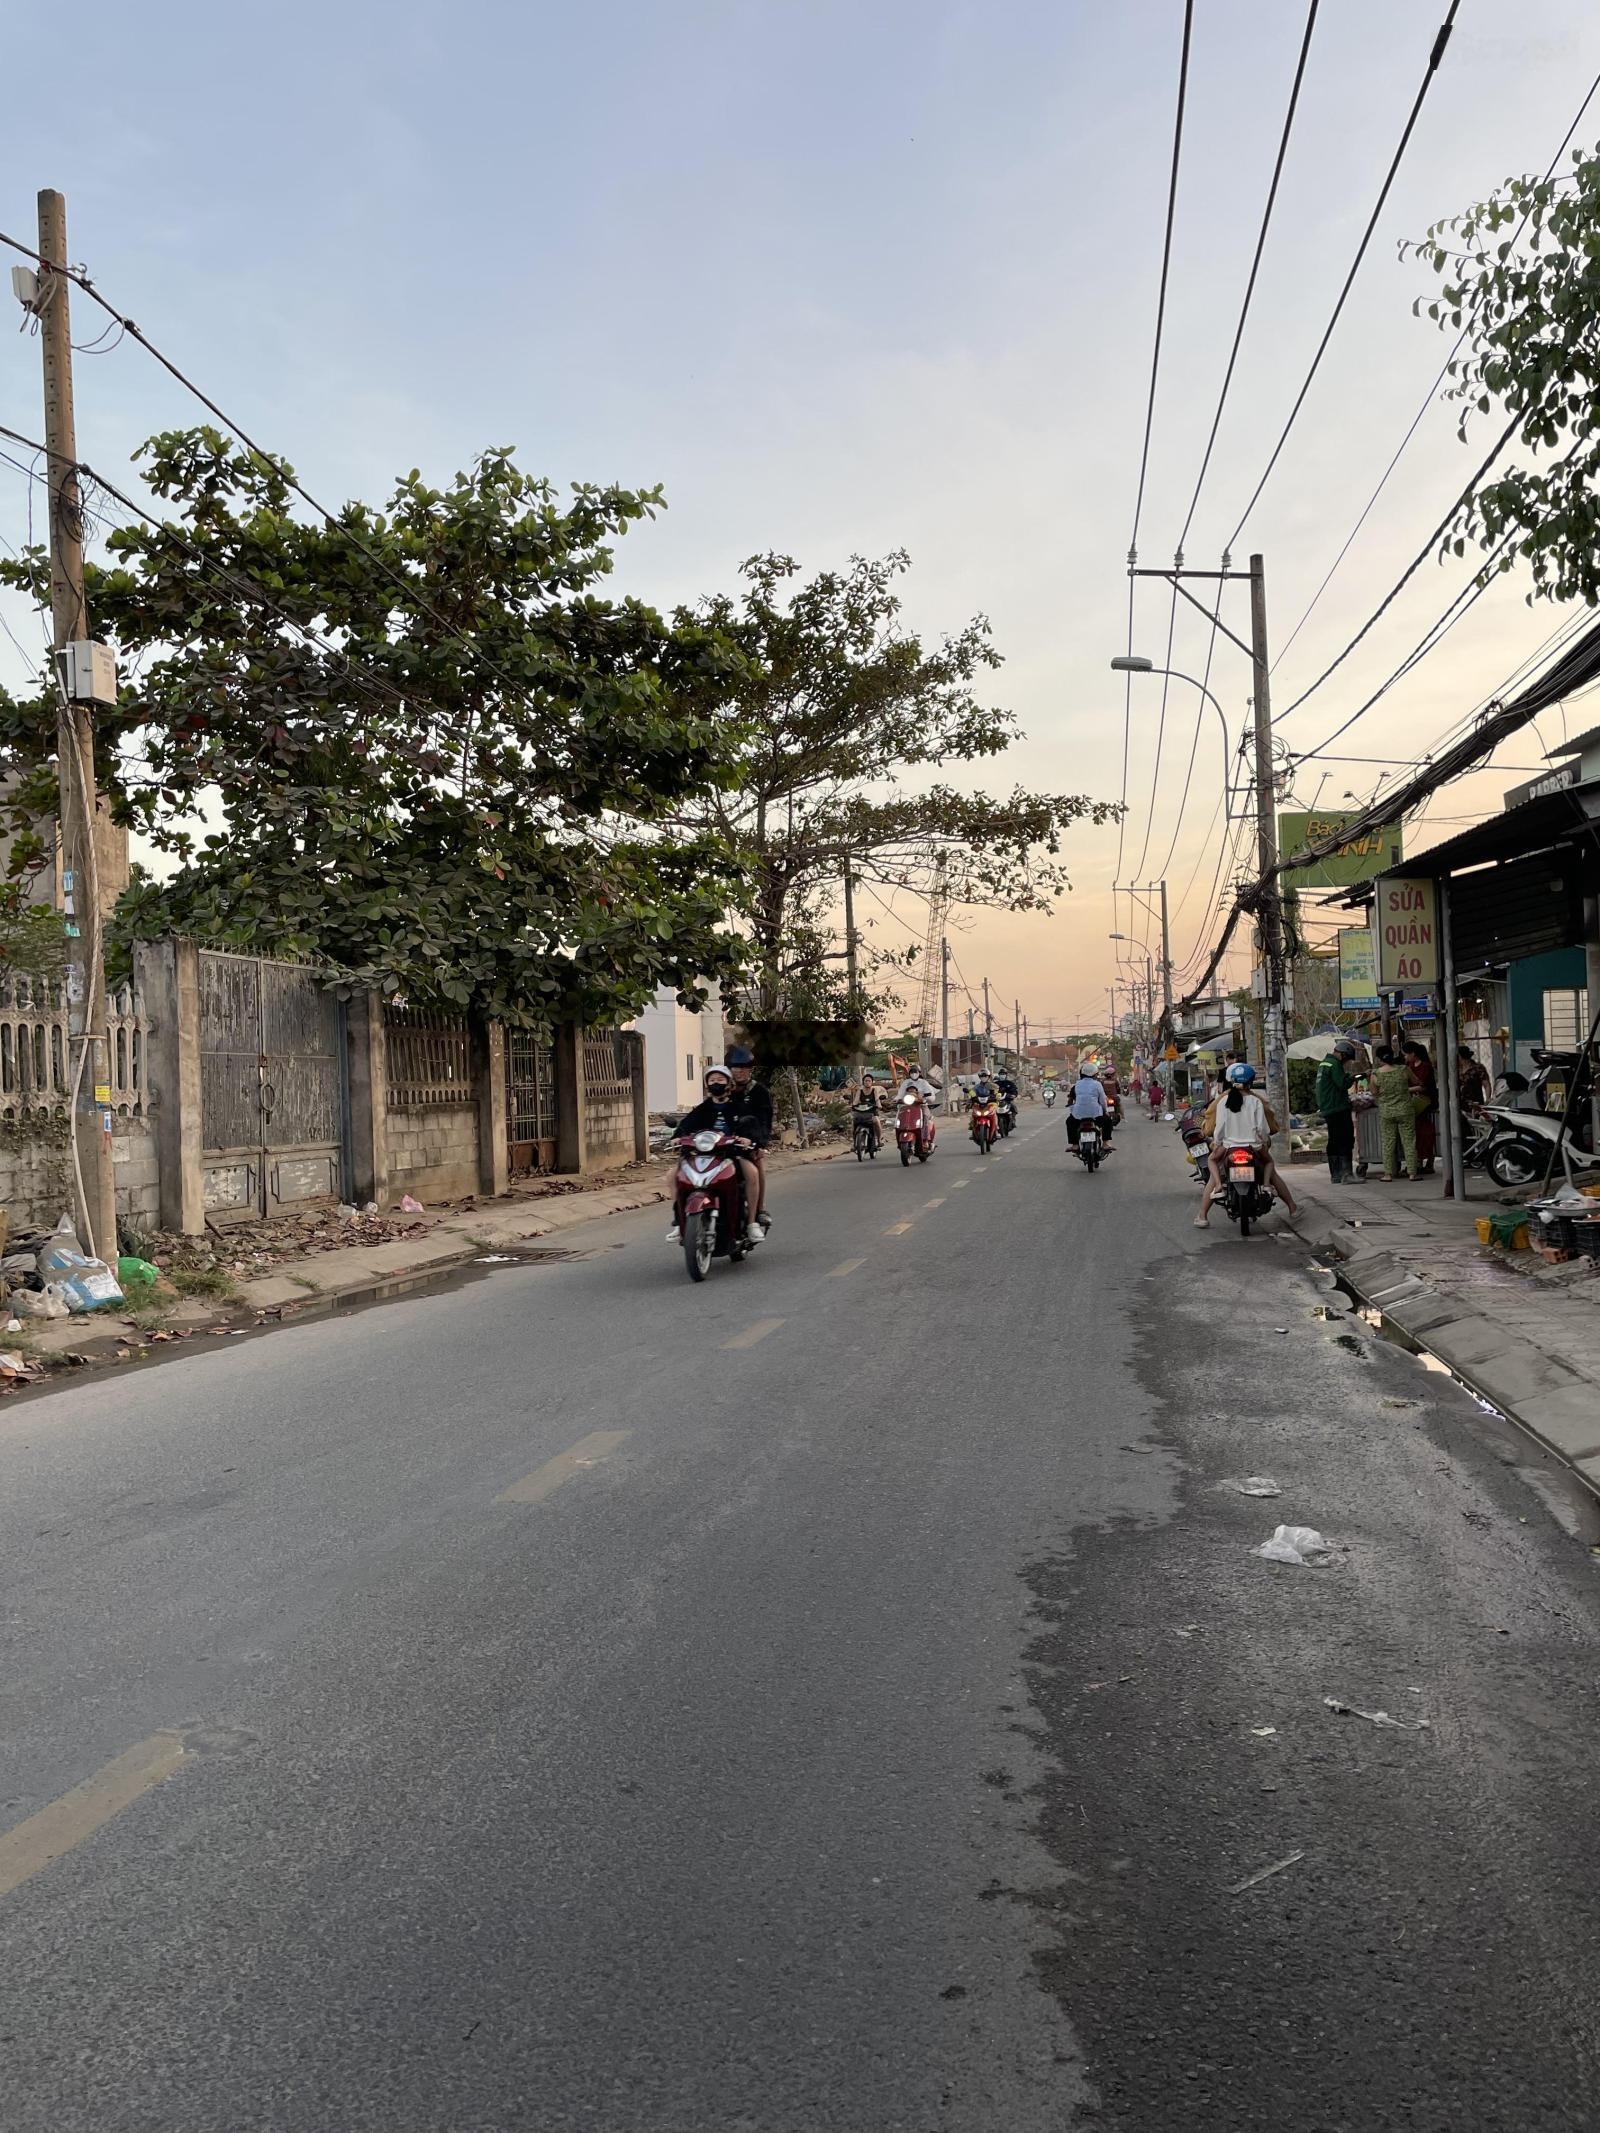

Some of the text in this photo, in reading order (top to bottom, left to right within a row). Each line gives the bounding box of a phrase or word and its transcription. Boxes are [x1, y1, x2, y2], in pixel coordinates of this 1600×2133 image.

[1389, 882, 1425, 912] SỬA
[1385, 915, 1432, 949] QUẦN
[1397, 953, 1422, 979] ÁO
